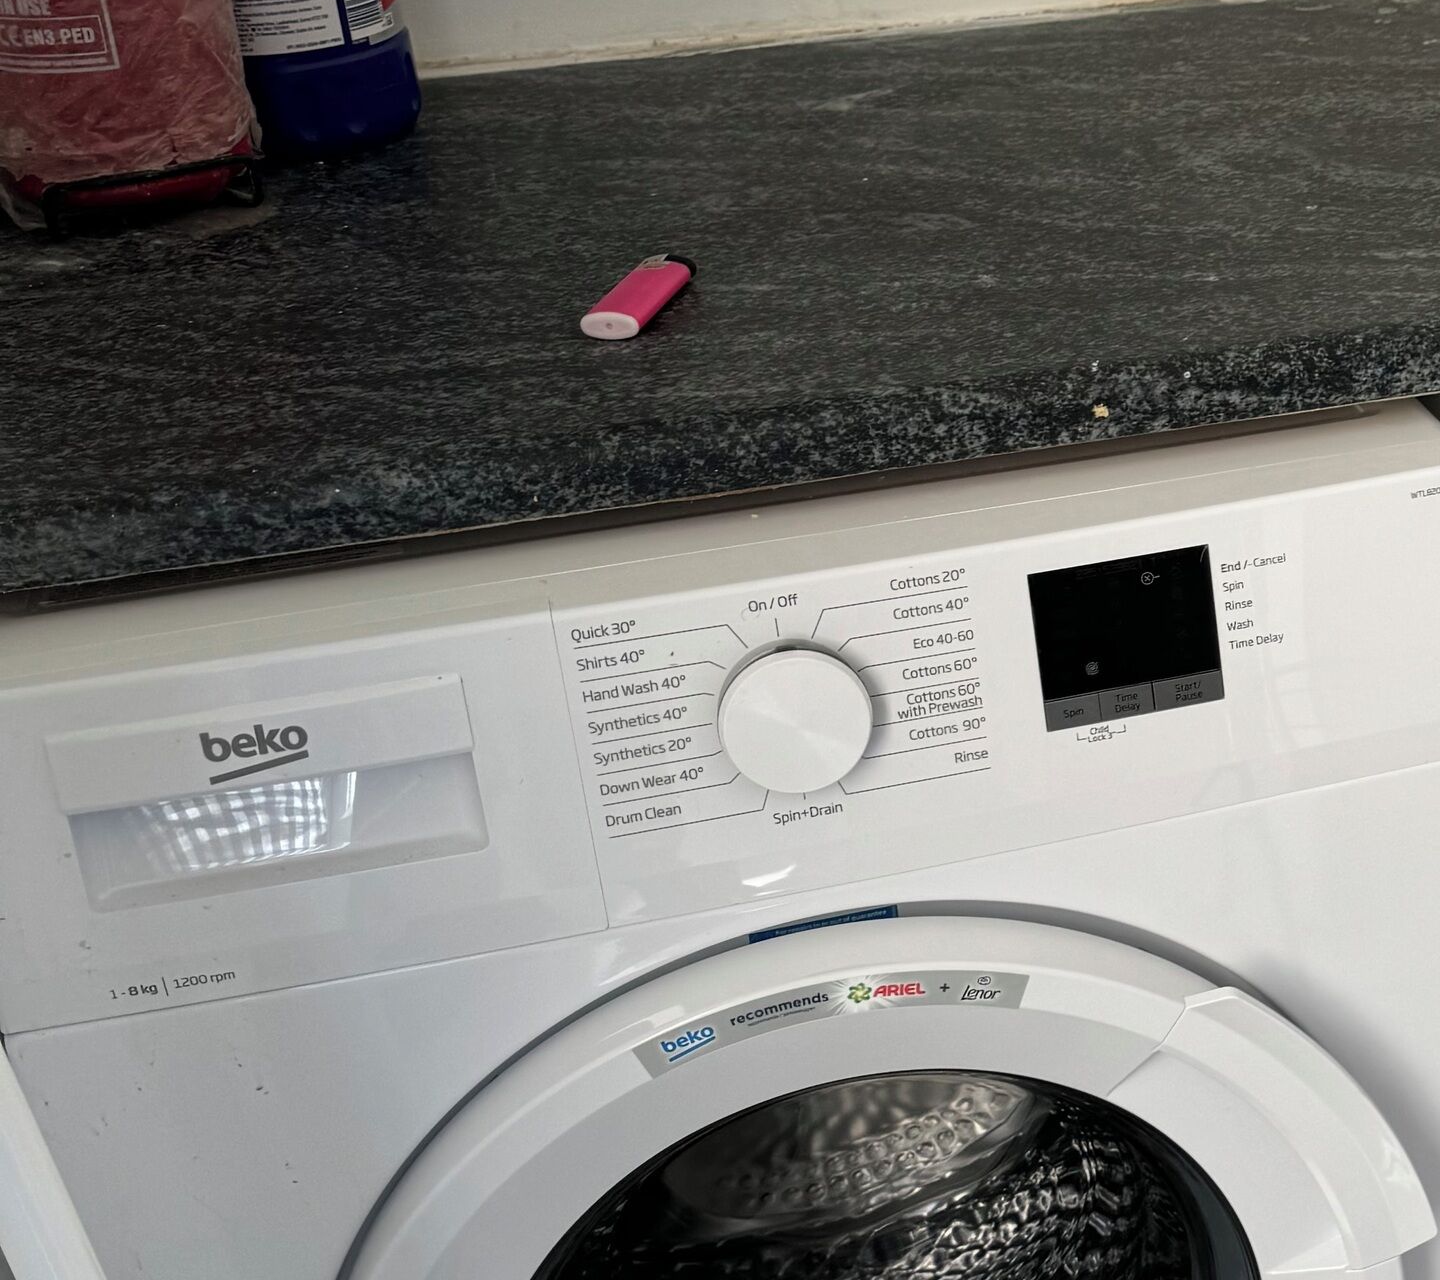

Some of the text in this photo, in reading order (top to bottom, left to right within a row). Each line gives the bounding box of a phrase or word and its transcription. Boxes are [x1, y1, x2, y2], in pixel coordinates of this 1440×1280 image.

[24, 27, 95, 46] EN3 PED
[1221, 561, 1241, 573] End
[890, 568, 966, 591] Cottons 20°
[1222, 581, 1244, 593] Spin
[748, 599, 767, 613] On
[777, 594, 798, 608] Off
[893, 597, 969, 620] Cottons 40°
[1225, 599, 1253, 611] Rinse
[571, 620, 636, 643] Quick 30°
[1227, 619, 1254, 632] Wash
[913, 630, 974, 649] Eco 40-60
[1229, 633, 1284, 650] Time Delay
[576, 650, 645, 672] Shirts 40°
[902, 657, 978, 680] Cottons 60°
[582, 675, 686, 703] Hand Wash 40°
[906, 682, 981, 705] Cottons 60°
[1116, 693, 1138, 702] Time
[1175, 690, 1204, 703] Pause
[898, 695, 983, 720] with Prewash
[1063, 708, 1084, 719] Spin
[1115, 703, 1140, 713] Delay
[587, 707, 688, 736] Synthetics 40°
[909, 717, 986, 741] Cottons 90°
[199, 724, 309, 763] beko
[593, 737, 692, 767] Synthetics 20°
[954, 750, 989, 764] Rinse
[599, 767, 704, 796] Down Wear 40°
[605, 804, 682, 828] Drum Clean
[773, 803, 844, 826] Spin+Drain
[173, 971, 236, 989] 1200 rpm
[872, 982, 926, 998] ARIEL
[109, 990, 118, 1000] 1
[140, 984, 159, 996] kg
[960, 985, 1001, 1001] Lenor
[729, 992, 830, 1027] recommends
[660, 1024, 715, 1055] beko
